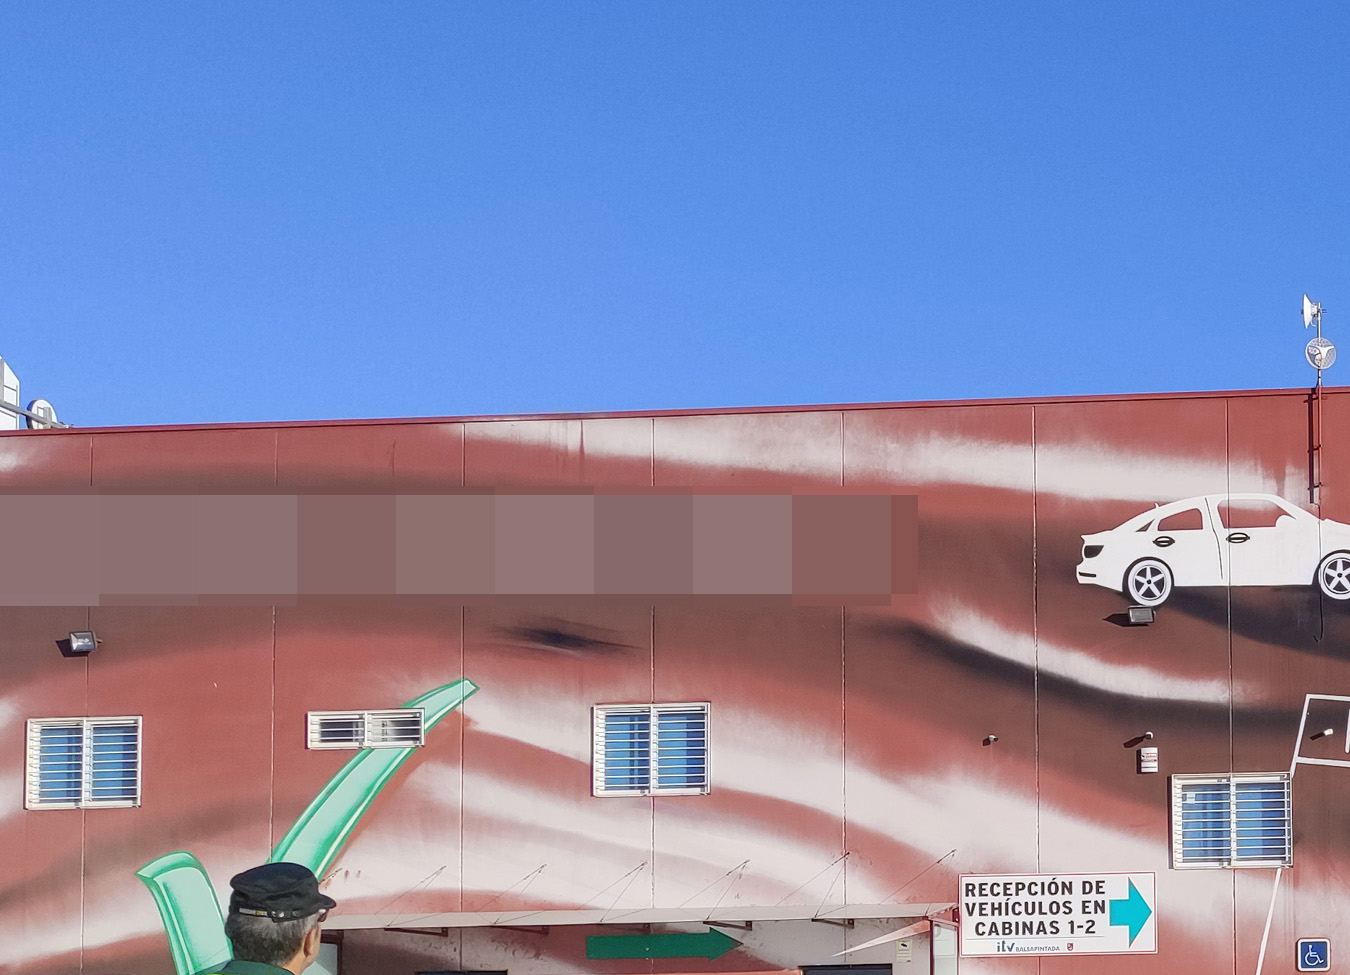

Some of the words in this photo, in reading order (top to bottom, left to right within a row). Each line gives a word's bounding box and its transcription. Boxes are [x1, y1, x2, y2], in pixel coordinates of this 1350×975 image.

[965, 877, 1073, 897] RECEPCIÓN
[1082, 880, 1106, 895] DE
[965, 898, 1073, 917] VEHÍCULOS
[1081, 899, 1106, 914] EN
[974, 920, 1060, 936] CABINAS
[1068, 920, 1096, 935] 1-2
